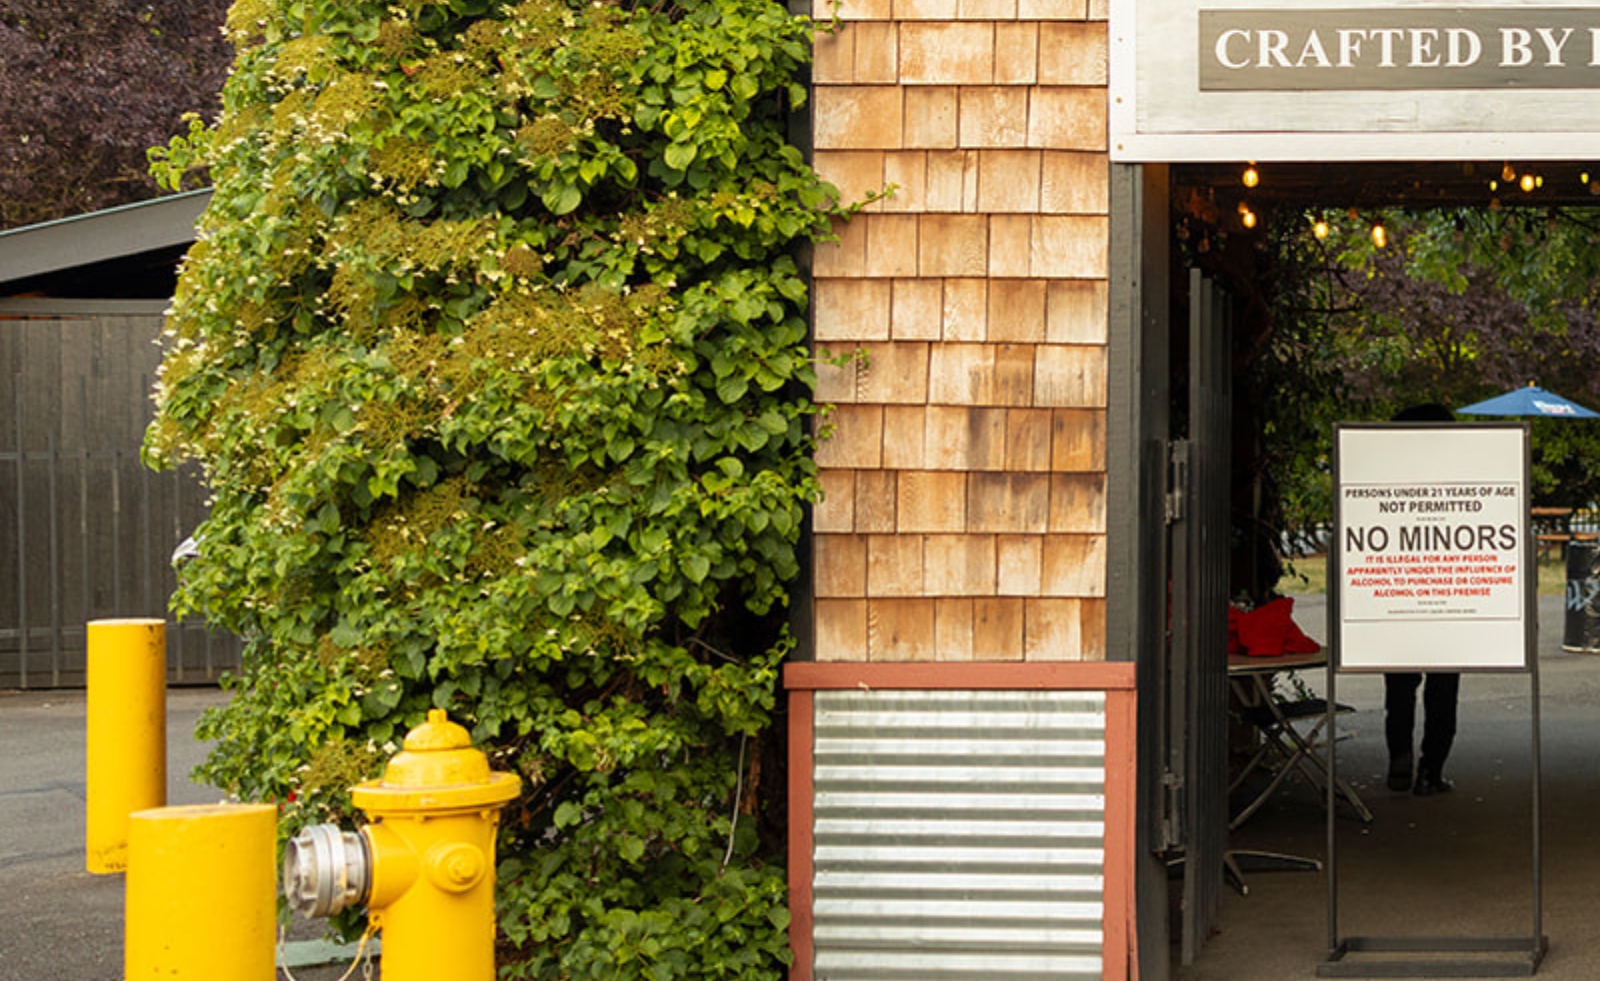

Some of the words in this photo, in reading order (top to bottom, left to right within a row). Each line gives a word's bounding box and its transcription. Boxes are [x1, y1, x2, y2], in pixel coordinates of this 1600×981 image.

[1214, 28, 1482, 69] CRAFTED
[1498, 27, 1574, 68] BY
[1345, 488, 1392, 498] PERSONS
[1394, 488, 1429, 498] UNDER
[1431, 488, 1443, 497] 21
[1446, 487, 1477, 497] YEARS
[1479, 487, 1493, 496] OF
[1495, 487, 1516, 497] AGE
[1379, 501, 1406, 513] NOT
[1409, 500, 1483, 512] PERMITTED
[1346, 526, 1389, 552] NO
[1399, 524, 1517, 552] MINORS
[1365, 555, 1374, 563] IT
[1376, 555, 1384, 563] IS
[1386, 555, 1421, 563] ILLEGAL
[1423, 555, 1441, 563] FOR
[1443, 555, 1461, 563] ANY
[1462, 554, 1498, 563] PERSON
[1346, 566, 1402, 575] APPARENTLY
[1404, 566, 1435, 575] UNDER
[1437, 566, 1453, 574] THE
[1455, 565, 1502, 574] INFLUENCE
[1504, 565, 1517, 573] OF
[1350, 578, 1393, 586] ALCOHOL
[1394, 578, 1406, 586] TO
[1408, 577, 1453, 586] PURCHASE
[1455, 576, 1468, 585] OR
[1470, 576, 1513, 585] CONSUME
[1373, 589, 1415, 597] ALCOHOL
[1416, 589, 1430, 597] ON
[1432, 588, 1451, 596] THIS
[1453, 587, 1491, 596] PREMISE
